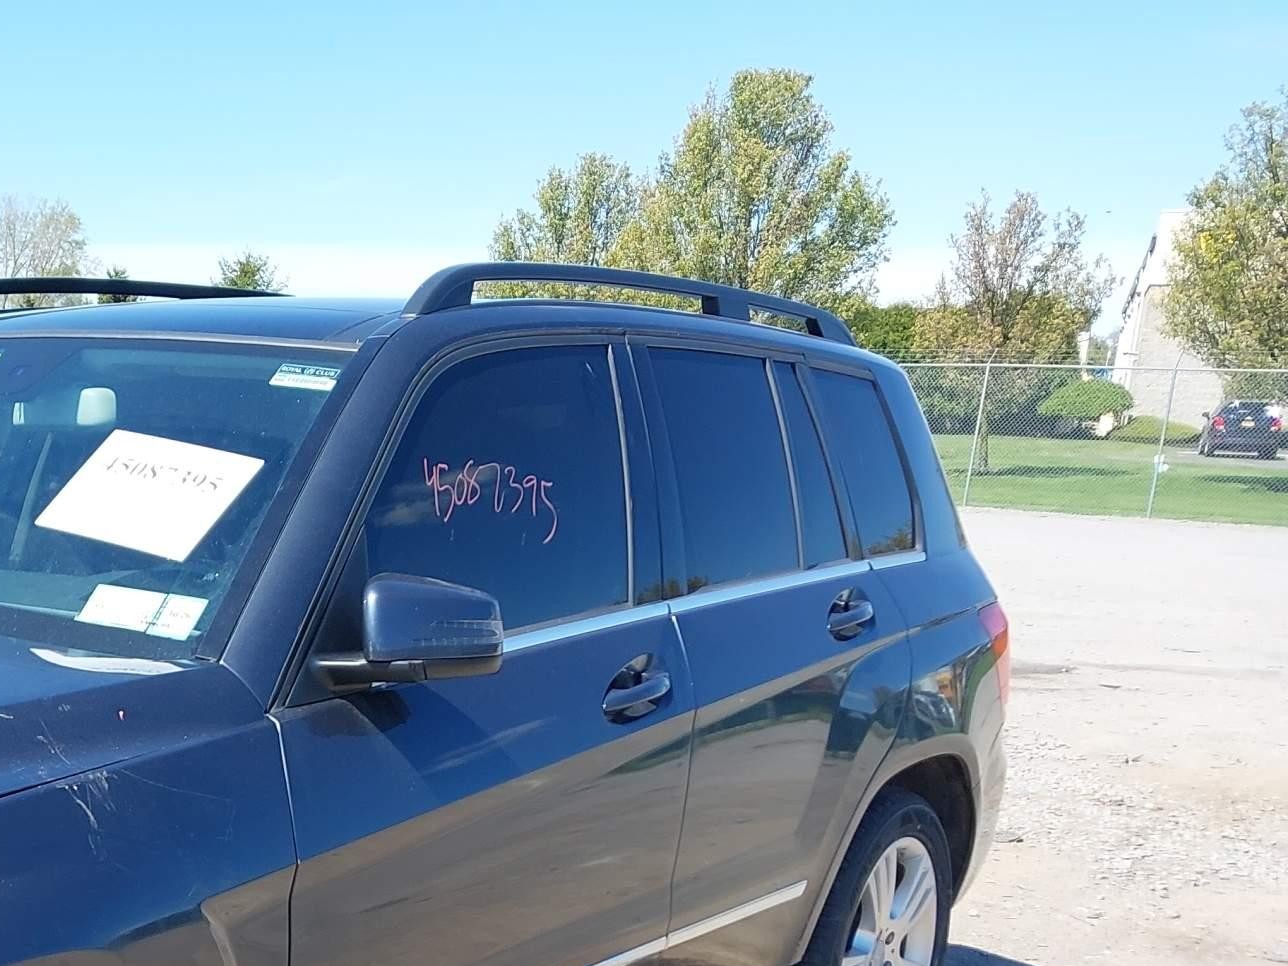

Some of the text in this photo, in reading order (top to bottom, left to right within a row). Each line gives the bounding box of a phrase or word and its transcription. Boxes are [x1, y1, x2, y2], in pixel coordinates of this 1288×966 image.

[280, 365, 303, 374] ROYAL
[315, 369, 336, 377] CLUB
[423, 457, 558, 545] 45087395
